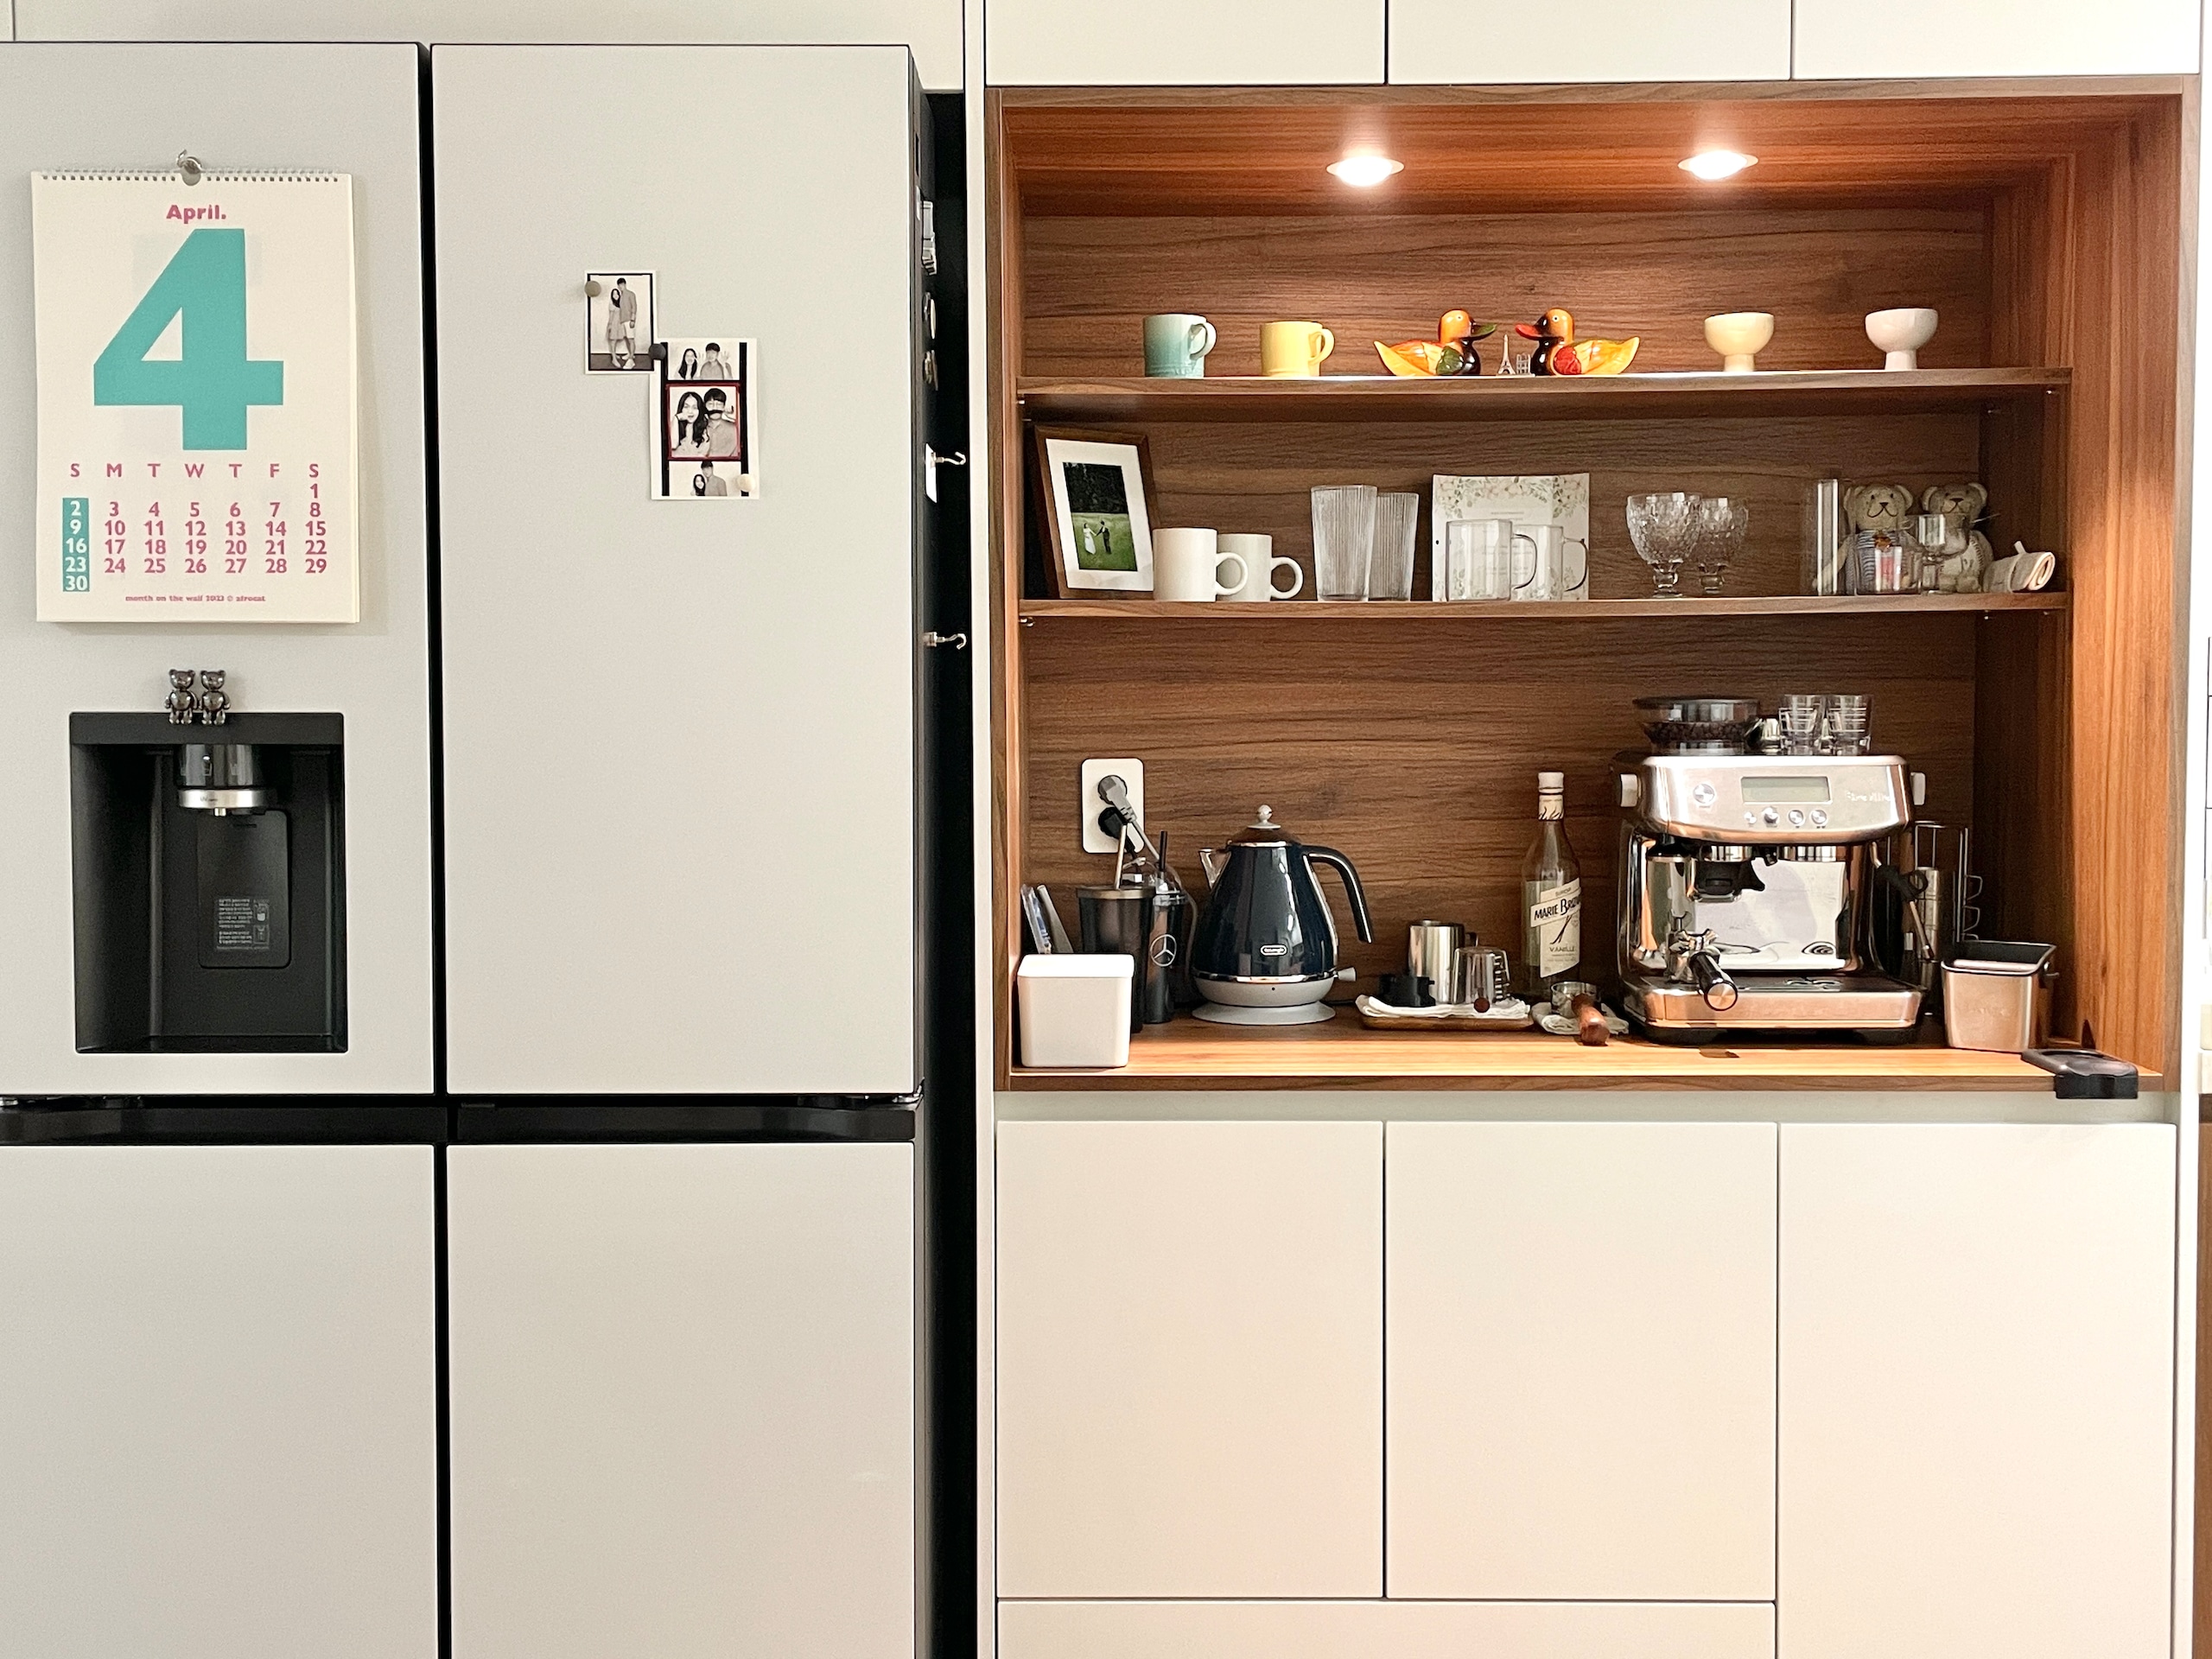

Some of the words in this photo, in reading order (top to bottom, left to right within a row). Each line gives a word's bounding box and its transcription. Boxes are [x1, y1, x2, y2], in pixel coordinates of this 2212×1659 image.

[166, 204, 226, 225] April.
[93, 228, 284, 450] 4
[70, 463, 80, 478] S
[106, 463, 123, 478] M
[148, 463, 161, 478] T
[184, 463, 205, 479] W
[228, 463, 243, 478] T
[269, 463, 280, 478] F
[308, 463, 319, 479] S
[310, 483, 319, 499] 1
[70, 499, 81, 517] 2
[110, 501, 119, 517] 3
[148, 501, 161, 517] 4
[189, 502, 200, 518] 5
[229, 502, 241, 518] 6
[270, 502, 281, 518] 7
[308, 502, 321, 518] 8
[70, 518, 82, 535] 9
[105, 519, 126, 536] 10
[144, 520, 164, 536] 11
[185, 520, 207, 537] 12
[226, 520, 246, 537] 13
[265, 521, 287, 537] 14
[305, 520, 327, 537] 15
[66, 537, 87, 554] 16
[105, 538, 125, 555] 17
[144, 538, 167, 555] 18
[185, 539, 207, 556] 19
[225, 539, 247, 556] 20
[265, 539, 285, 556] 21
[305, 539, 327, 556] 22
[65, 556, 86, 573] 23
[104, 557, 126, 574] 24
[144, 557, 166, 574] 25
[185, 558, 207, 574] 26
[225, 557, 247, 575] 27
[265, 557, 288, 574] 28
[305, 557, 327, 575] 29
[65, 575, 88, 591] 30
[1535, 904, 1558, 920] MARIE
